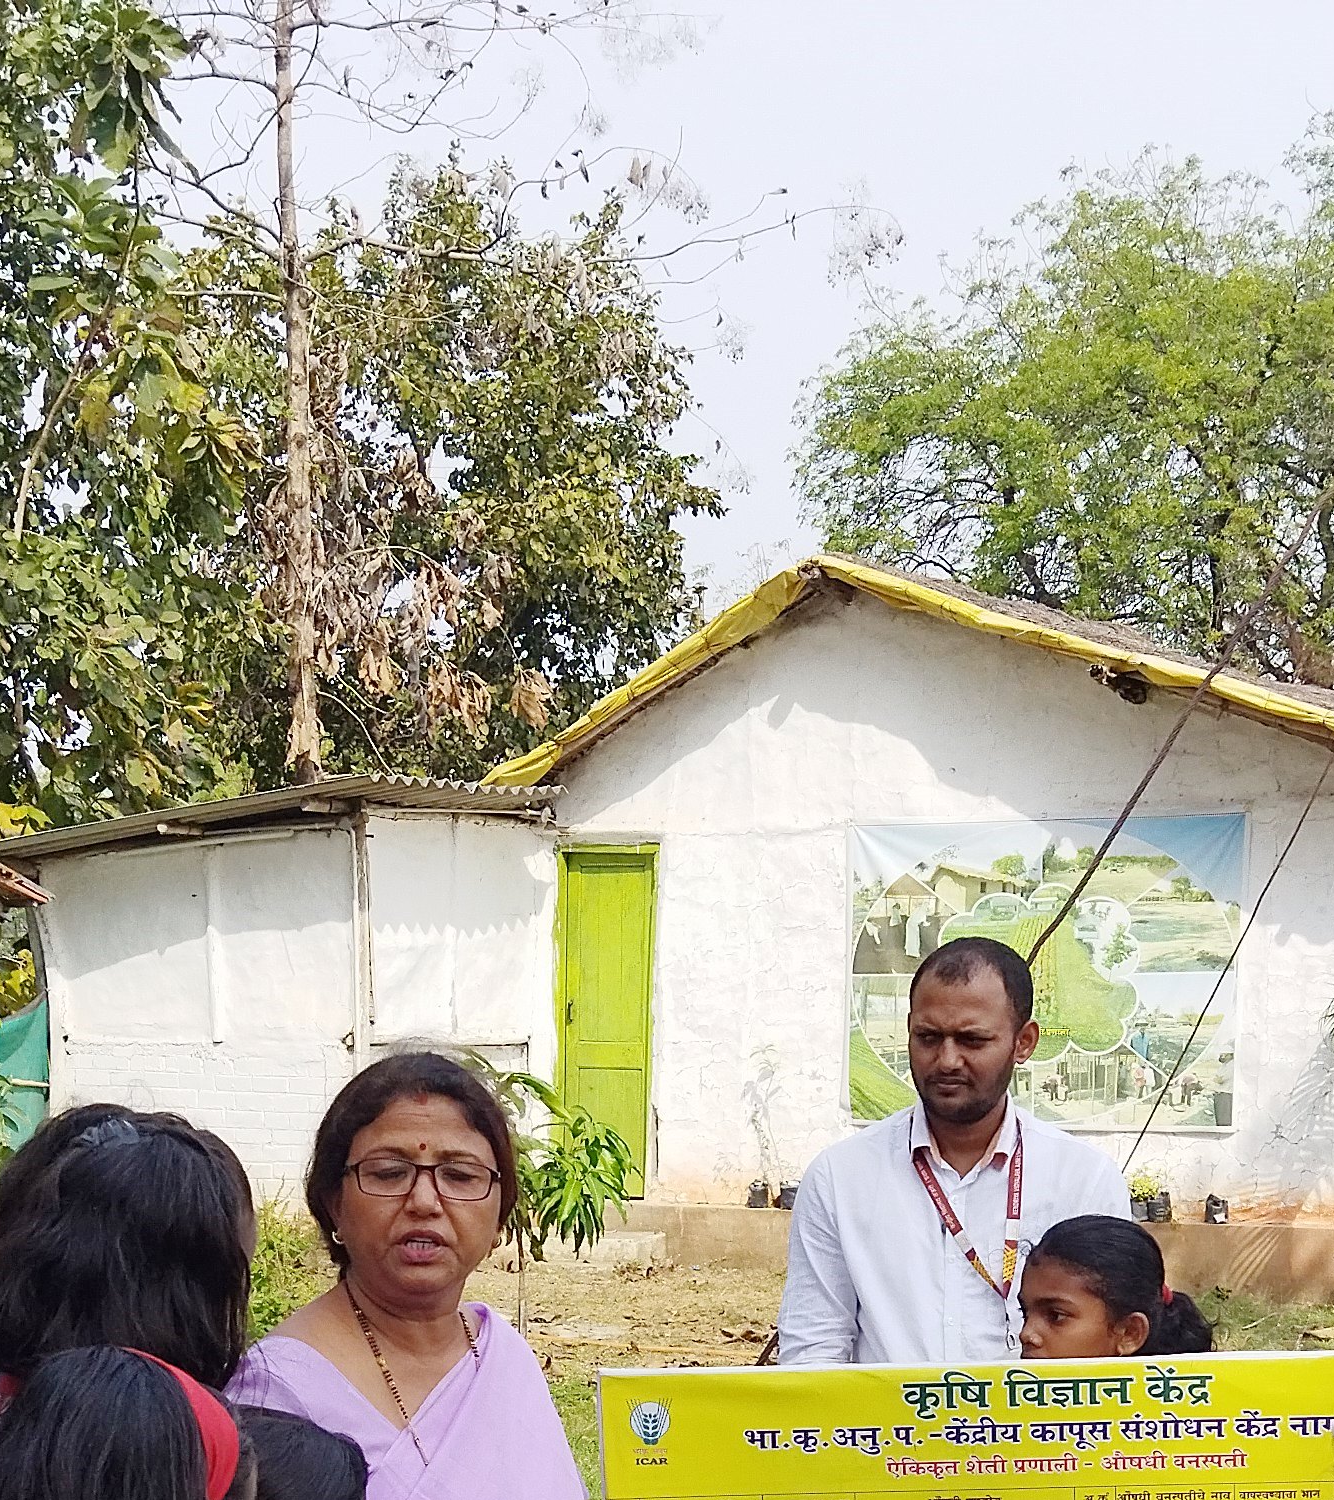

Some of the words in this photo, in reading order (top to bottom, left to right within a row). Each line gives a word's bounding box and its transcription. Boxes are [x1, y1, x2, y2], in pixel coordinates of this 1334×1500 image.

[902, 1370, 993, 1420] कृषि
[1004, 1368, 1135, 1408] विज्ञान
[1145, 1364, 1214, 1406] केंद्र
[1030, 1420, 1112, 1450] कापूस
[1119, 1412, 1225, 1441] संशोधन
[1234, 1410, 1280, 1439] केंद्र
[635, 1457, 668, 1466] ICAR
[886, 1458, 960, 1480] ऐकिकृत
[965, 1454, 1007, 1476] शेती
[1014, 1452, 1079, 1474] प्रणाली
[1101, 1451, 1167, 1471] औषधी
[1172, 1448, 1249, 1470] वनस्पती
[1210, 1490, 1231, 1500] नाव
